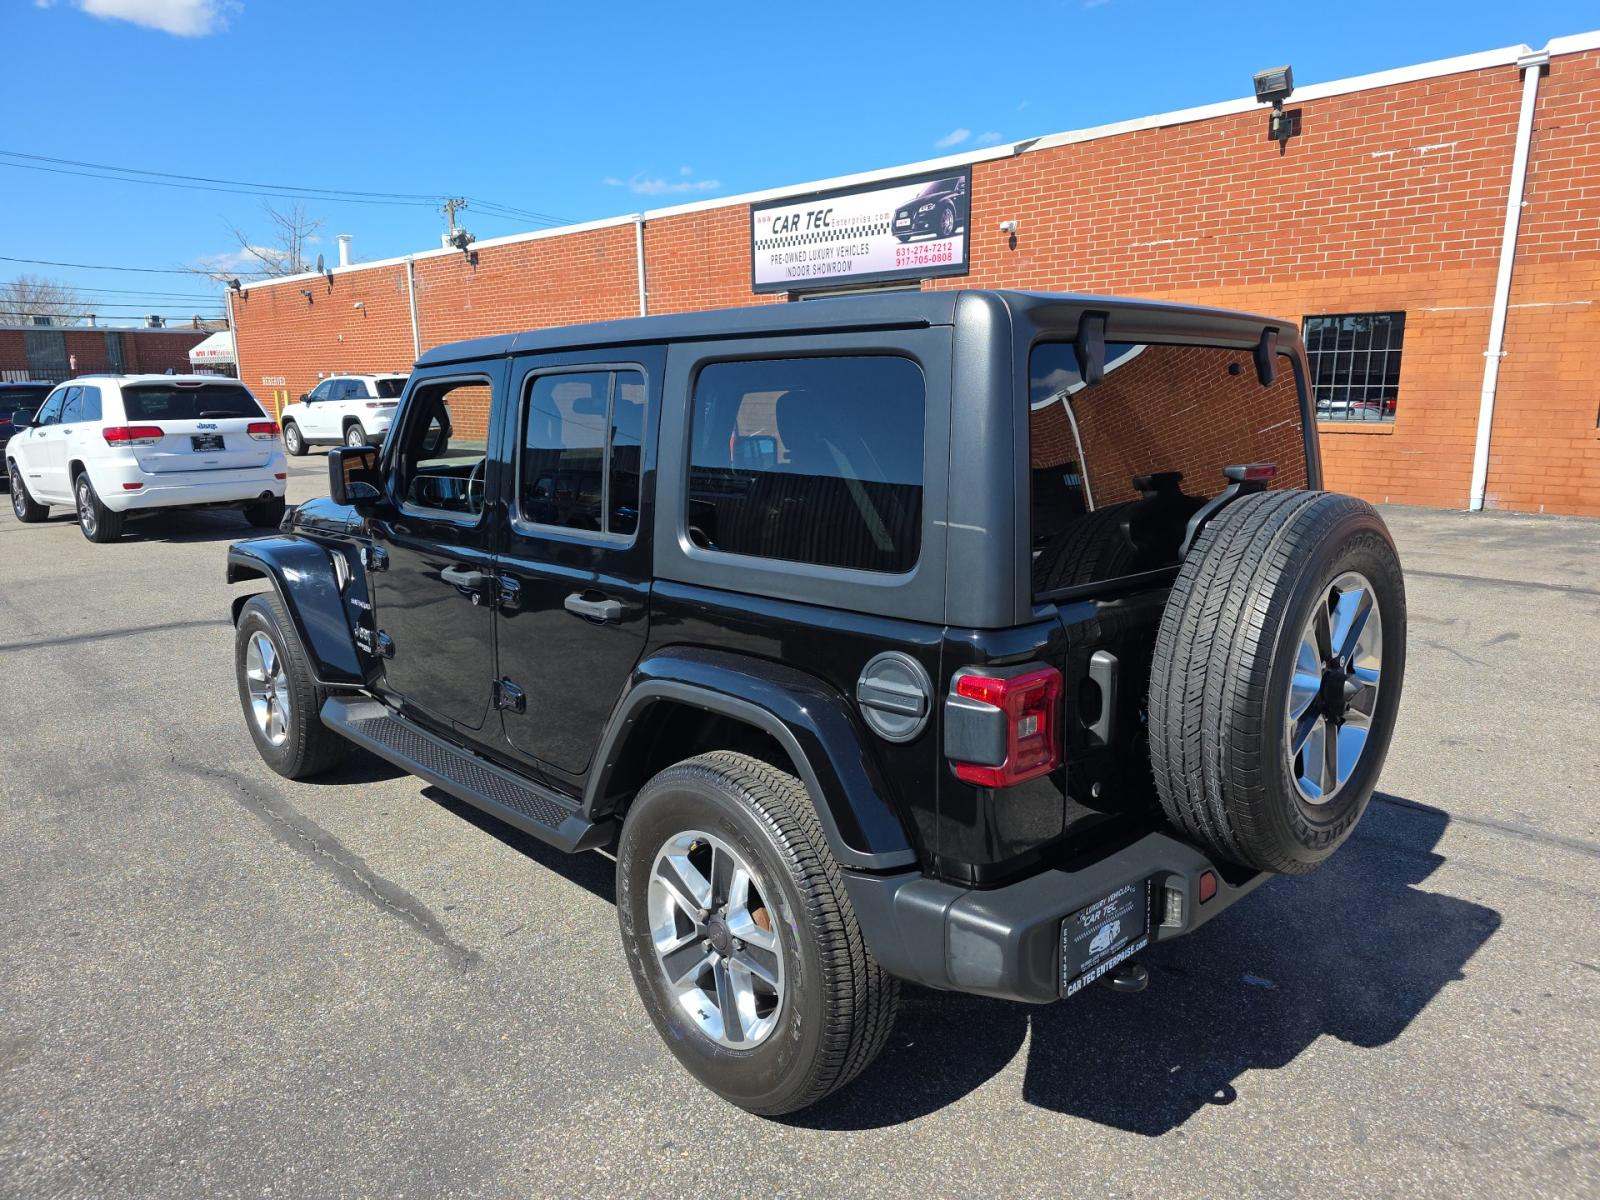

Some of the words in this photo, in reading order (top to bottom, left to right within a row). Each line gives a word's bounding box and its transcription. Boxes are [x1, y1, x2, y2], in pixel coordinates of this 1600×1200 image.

[772, 213, 800, 235] CAR
[806, 208, 833, 230] TEC
[770, 250, 807, 266] PRE-OWNED
[808, 247, 834, 262] LUXURY
[836, 243, 870, 258] VEHICLES
[896, 242, 953, 257] 631-274-7212
[896, 252, 953, 267] 917-705-0808
[785, 265, 810, 278] INDOOR
[813, 260, 852, 276] SHOWROOM
[1084, 910, 1101, 927] CAR
[1103, 900, 1118, 917] TEC
[1067, 980, 1082, 997] CAR
[1083, 969, 1096, 986] TEC
